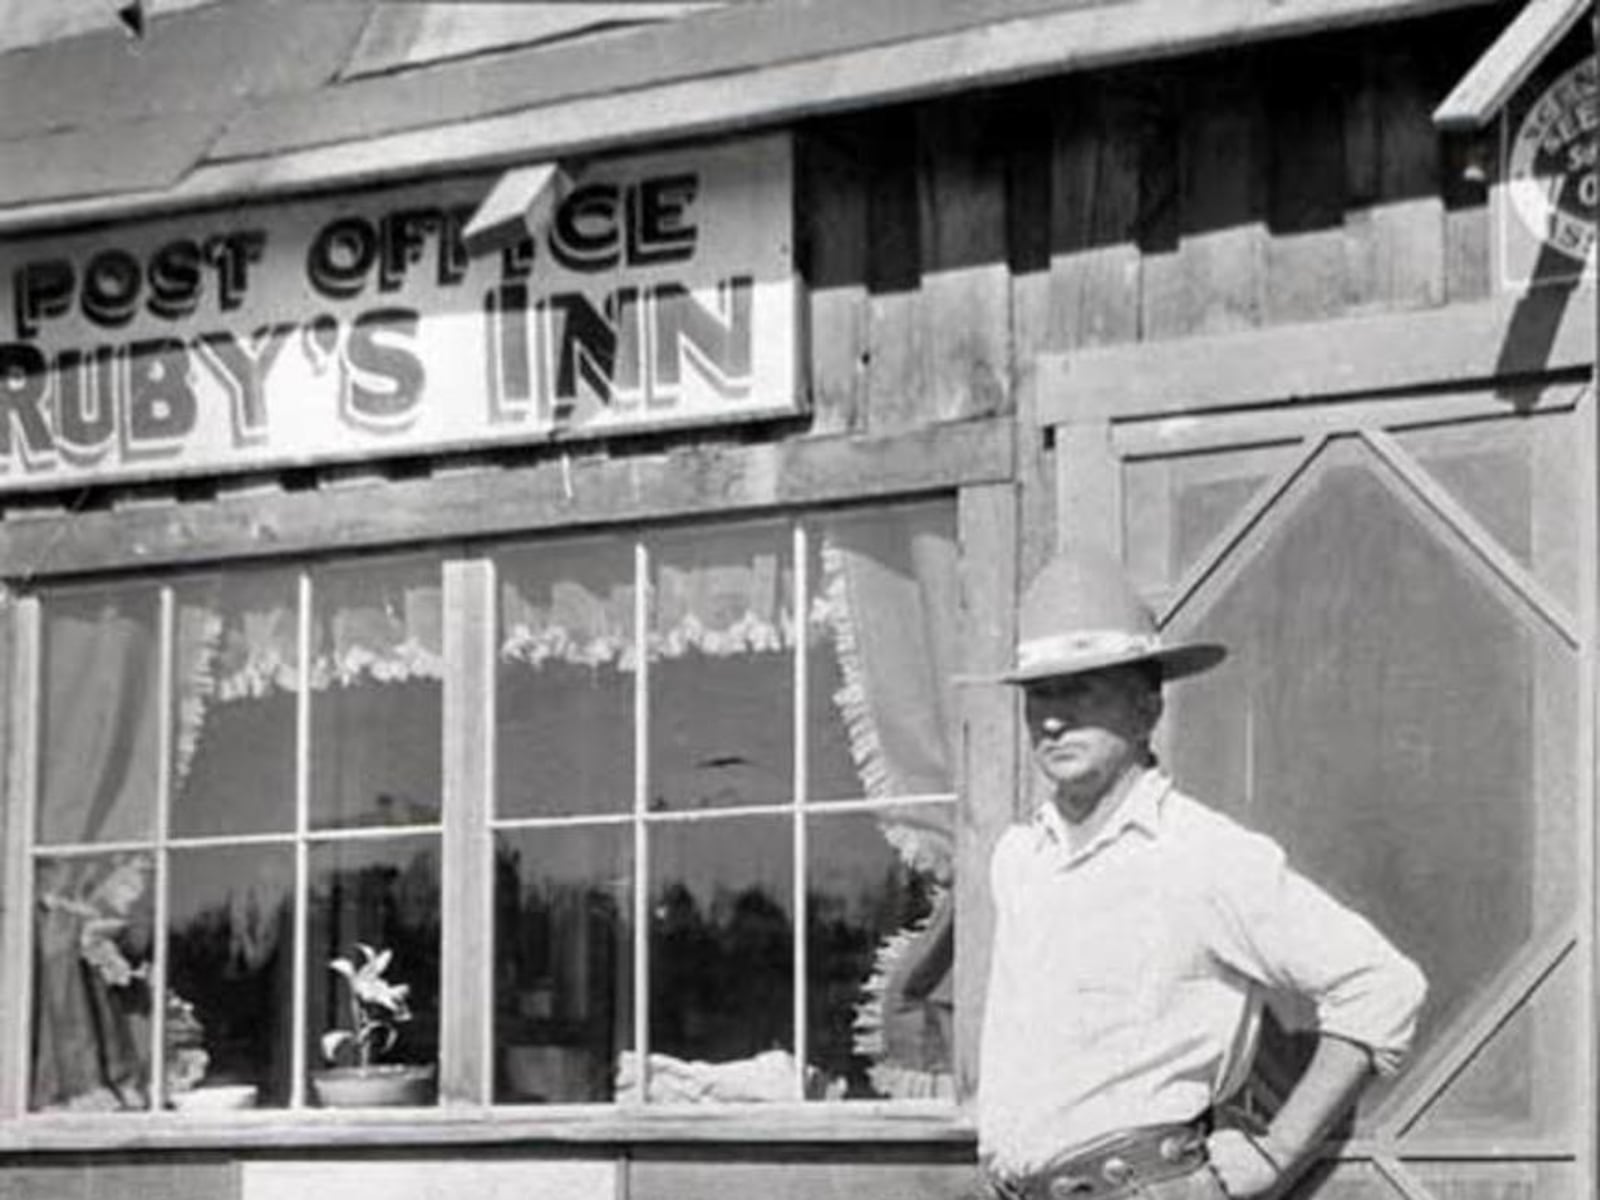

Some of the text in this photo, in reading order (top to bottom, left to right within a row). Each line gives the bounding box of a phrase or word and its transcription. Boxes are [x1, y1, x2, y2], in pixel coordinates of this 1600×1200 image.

[14, 230, 267, 339] POST
[0, 276, 755, 472] RUBY'S INN
